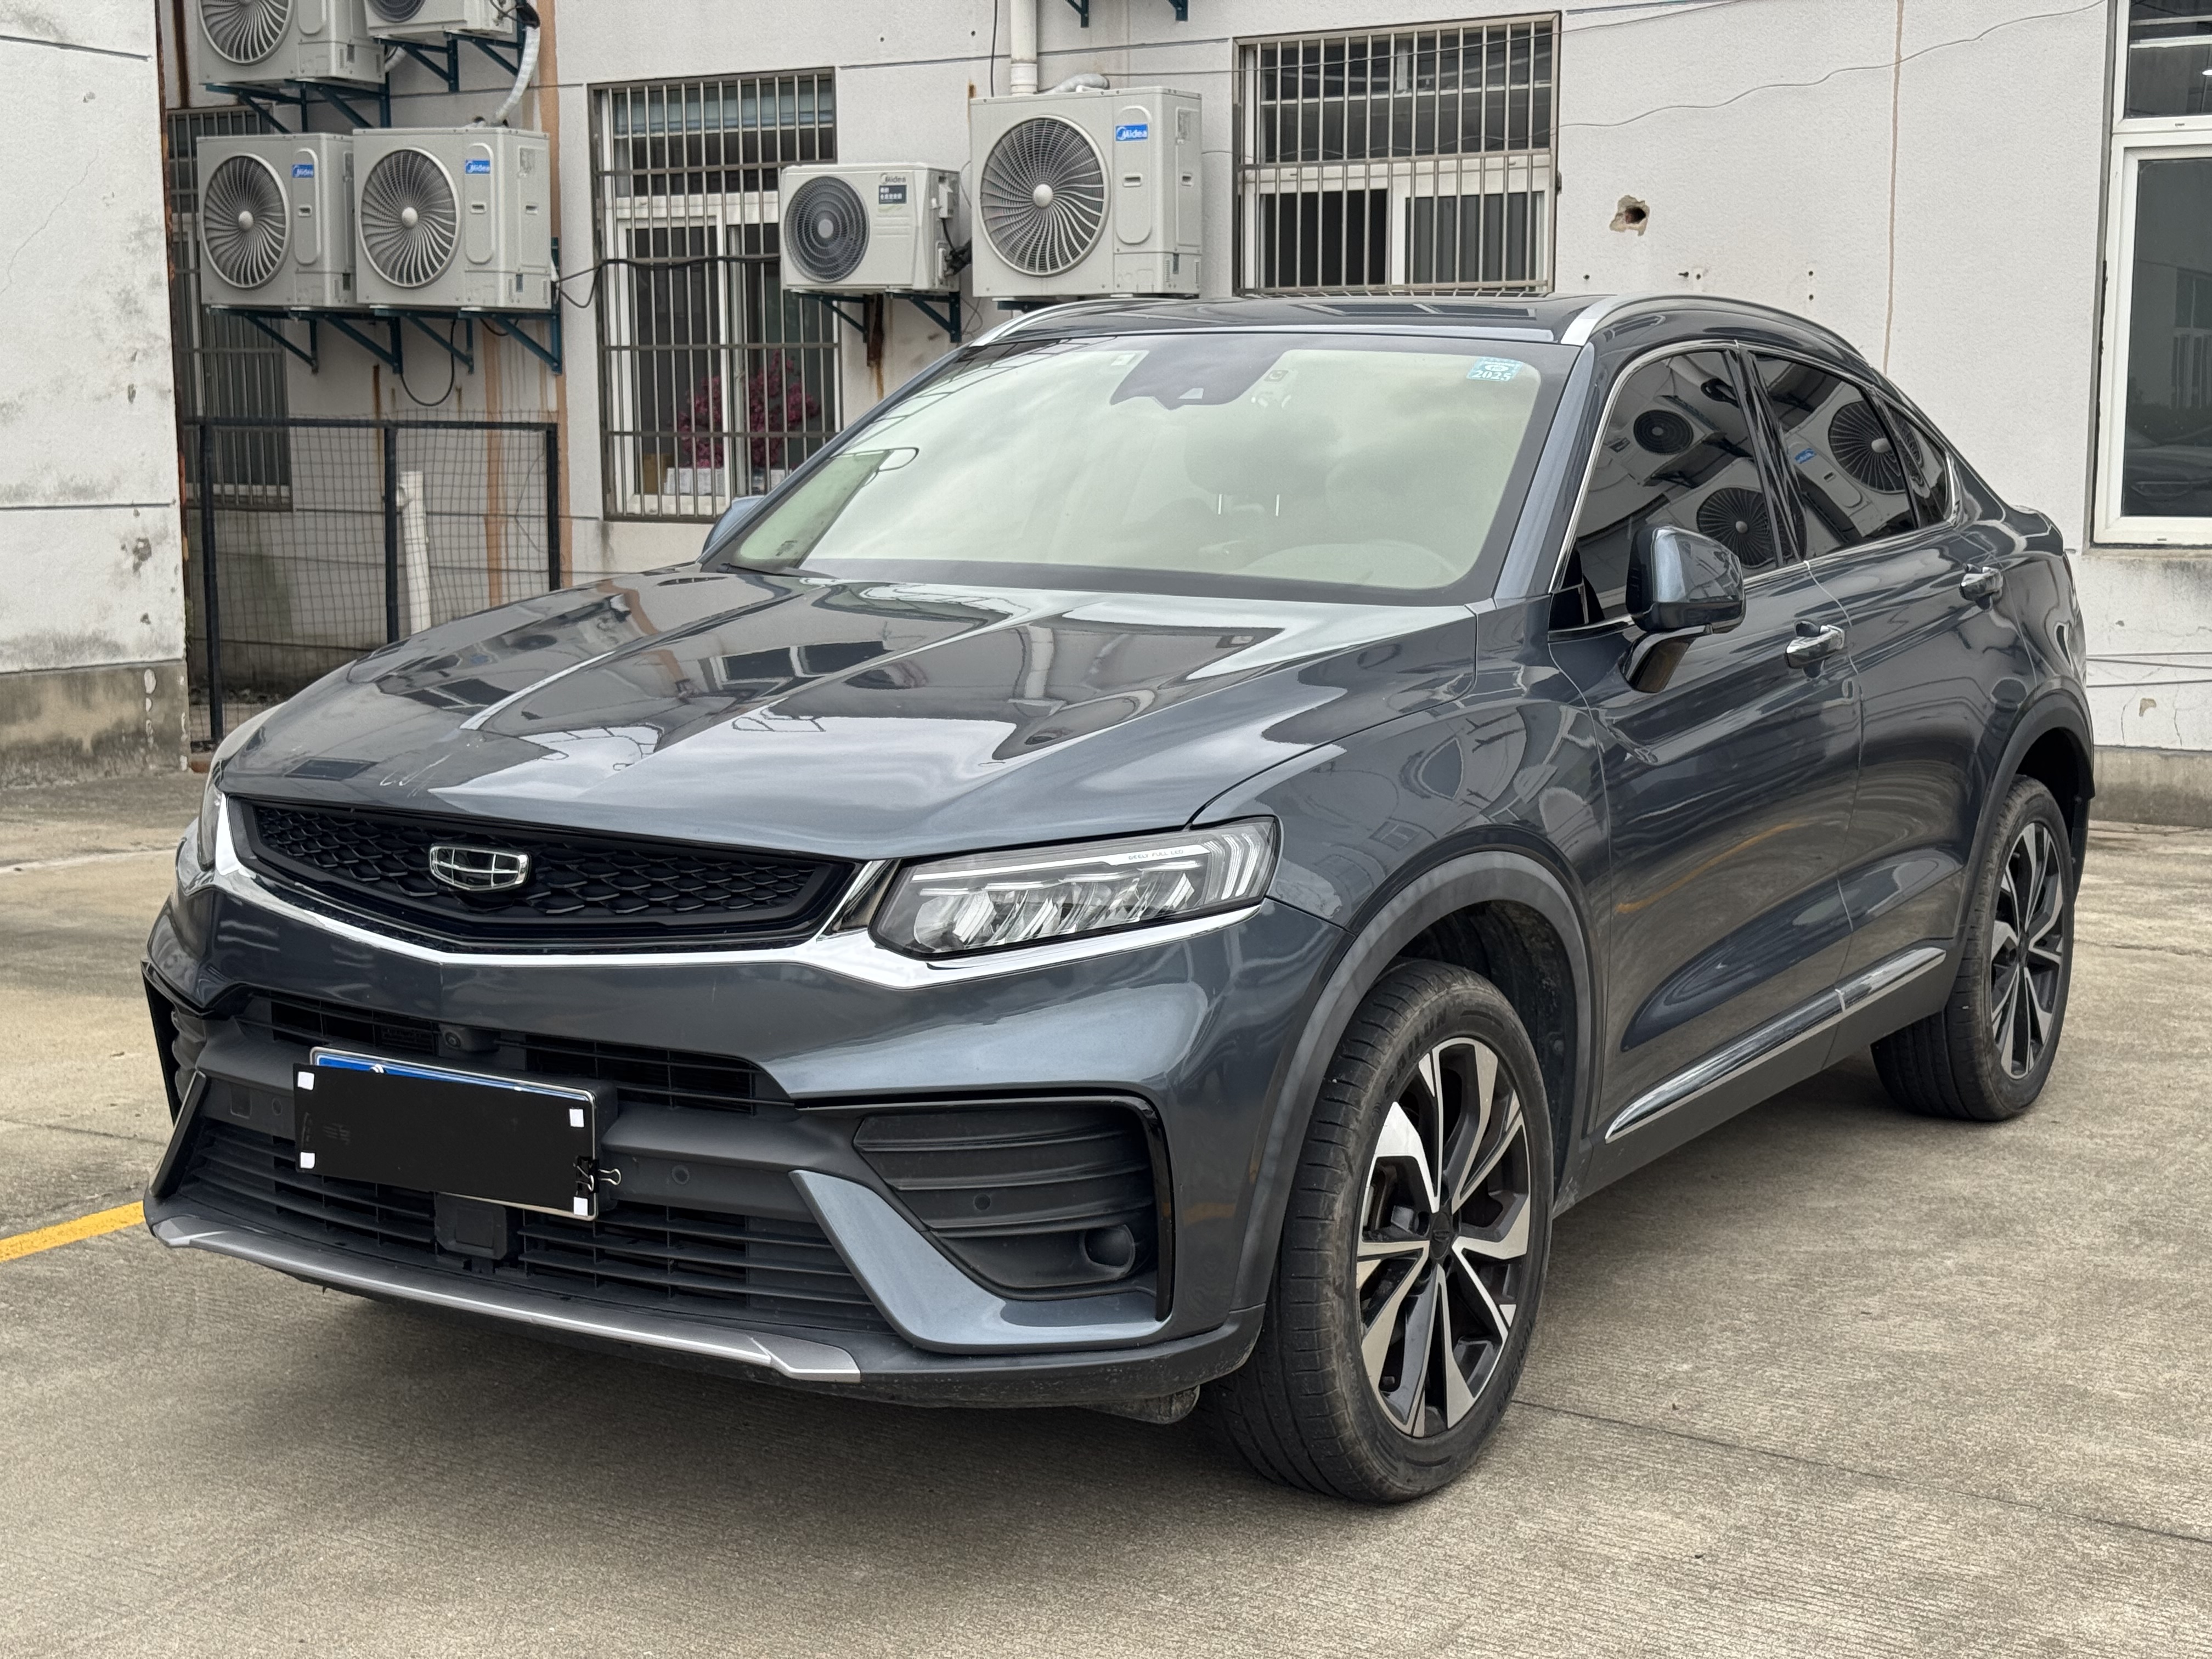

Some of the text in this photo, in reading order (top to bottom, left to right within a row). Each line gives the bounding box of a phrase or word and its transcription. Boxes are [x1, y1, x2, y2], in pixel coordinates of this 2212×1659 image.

[1118, 127, 1147, 139] Midea
[882, 173, 906, 183] Midea
[1472, 370, 1511, 381] 2025
[1384, 1008, 1447, 1099] SAILUN
